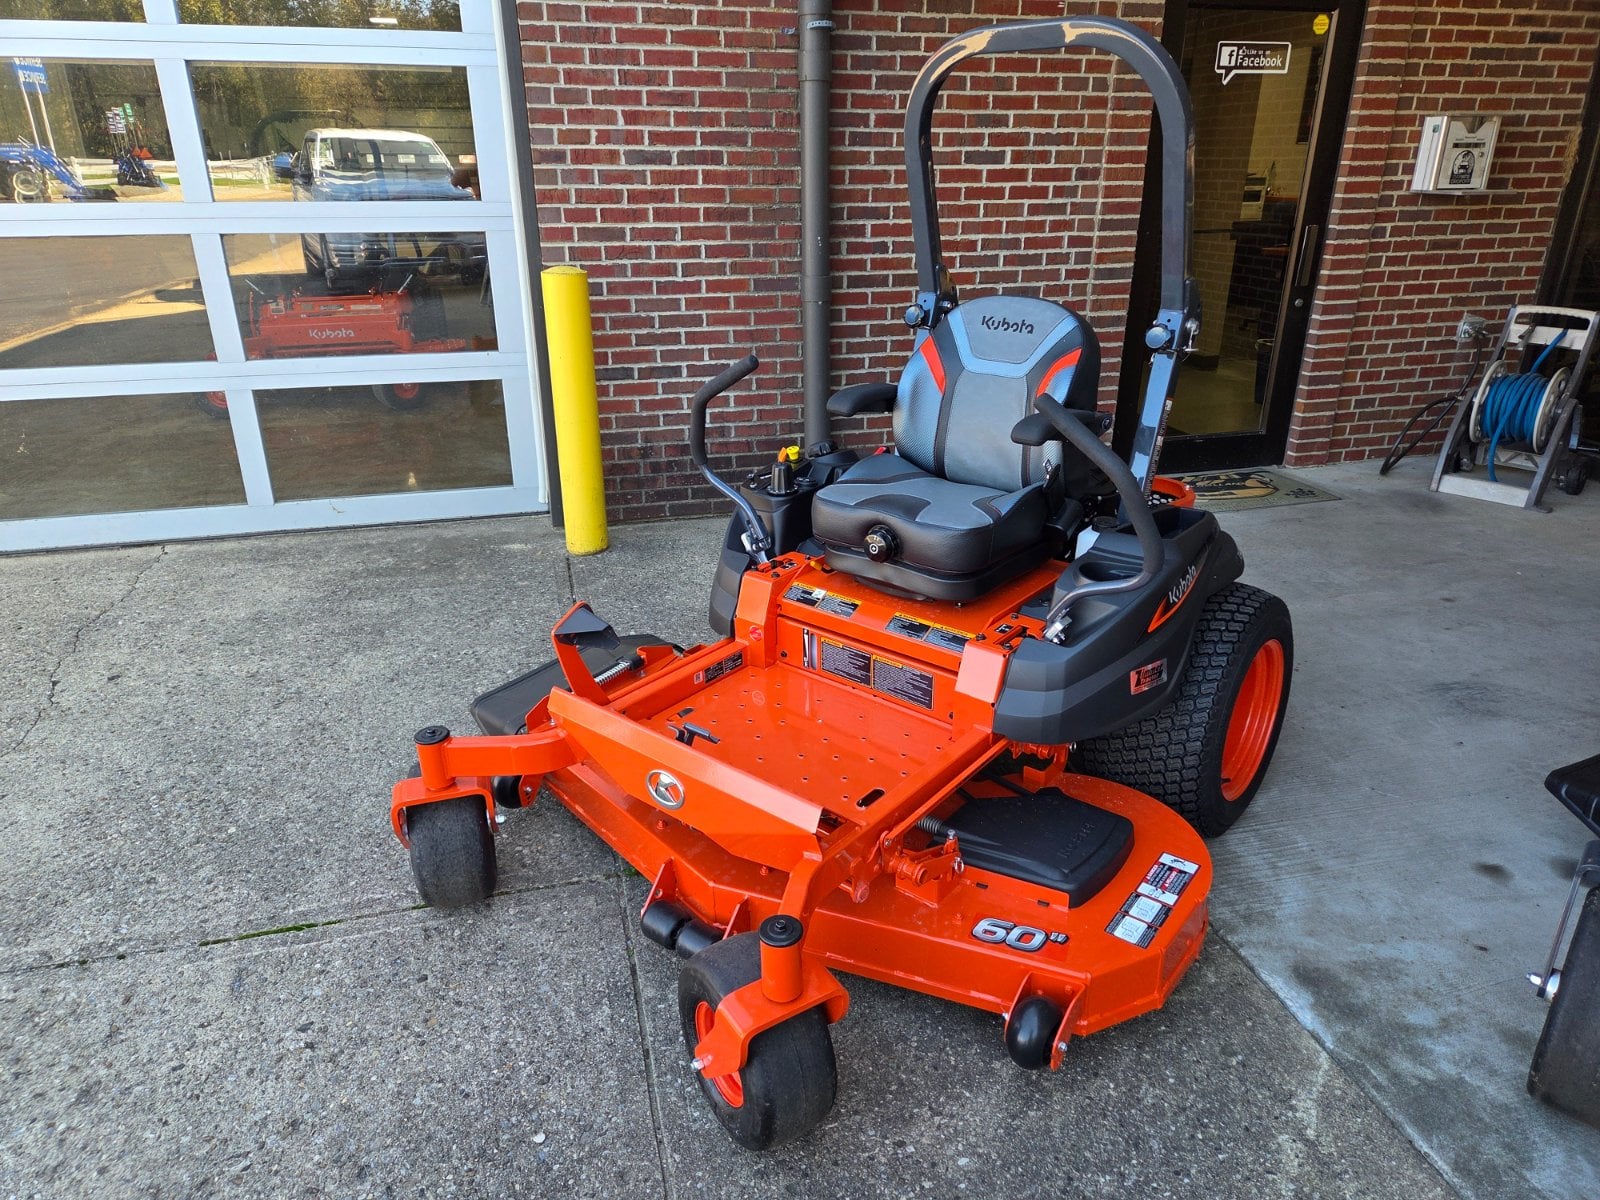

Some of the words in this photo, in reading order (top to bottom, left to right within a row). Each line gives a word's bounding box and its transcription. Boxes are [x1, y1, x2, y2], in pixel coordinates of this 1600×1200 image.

[1237, 54, 1283, 67] Facebook
[308, 327, 356, 340] Kubota
[981, 315, 1035, 335] Kubota
[1168, 564, 1197, 604] Kubota
[971, 917, 1070, 952] 60"
